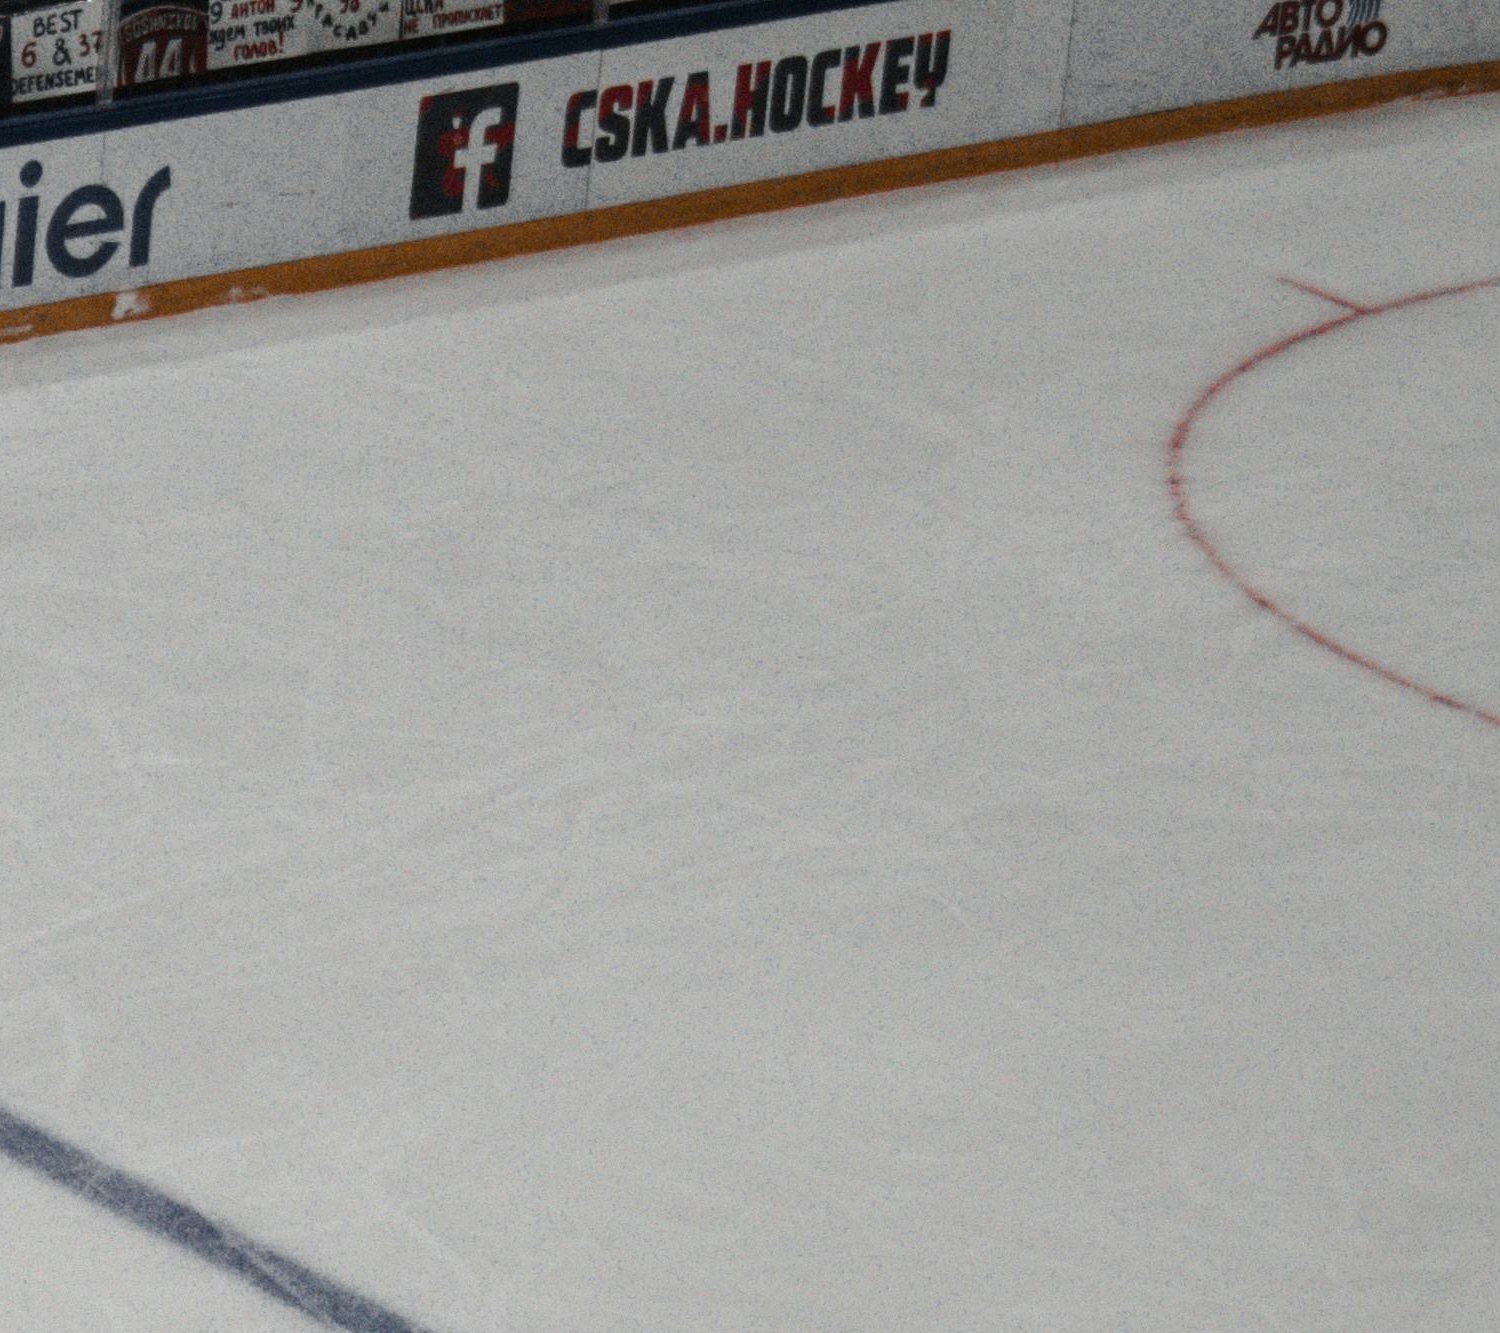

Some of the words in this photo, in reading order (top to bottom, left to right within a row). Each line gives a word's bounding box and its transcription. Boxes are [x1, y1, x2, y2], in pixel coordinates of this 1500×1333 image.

[33, 9, 83, 37] BEST
[1253, 0, 1343, 39] АВТО
[22, 41, 37, 68] 6
[53, 39, 71, 67] &
[135, 36, 183, 84] 44
[1274, 21, 1388, 70] РАДИО
[11, 67, 98, 97] DEFENSEME
[562, 30, 952, 168] CSKA.HOCKEY
